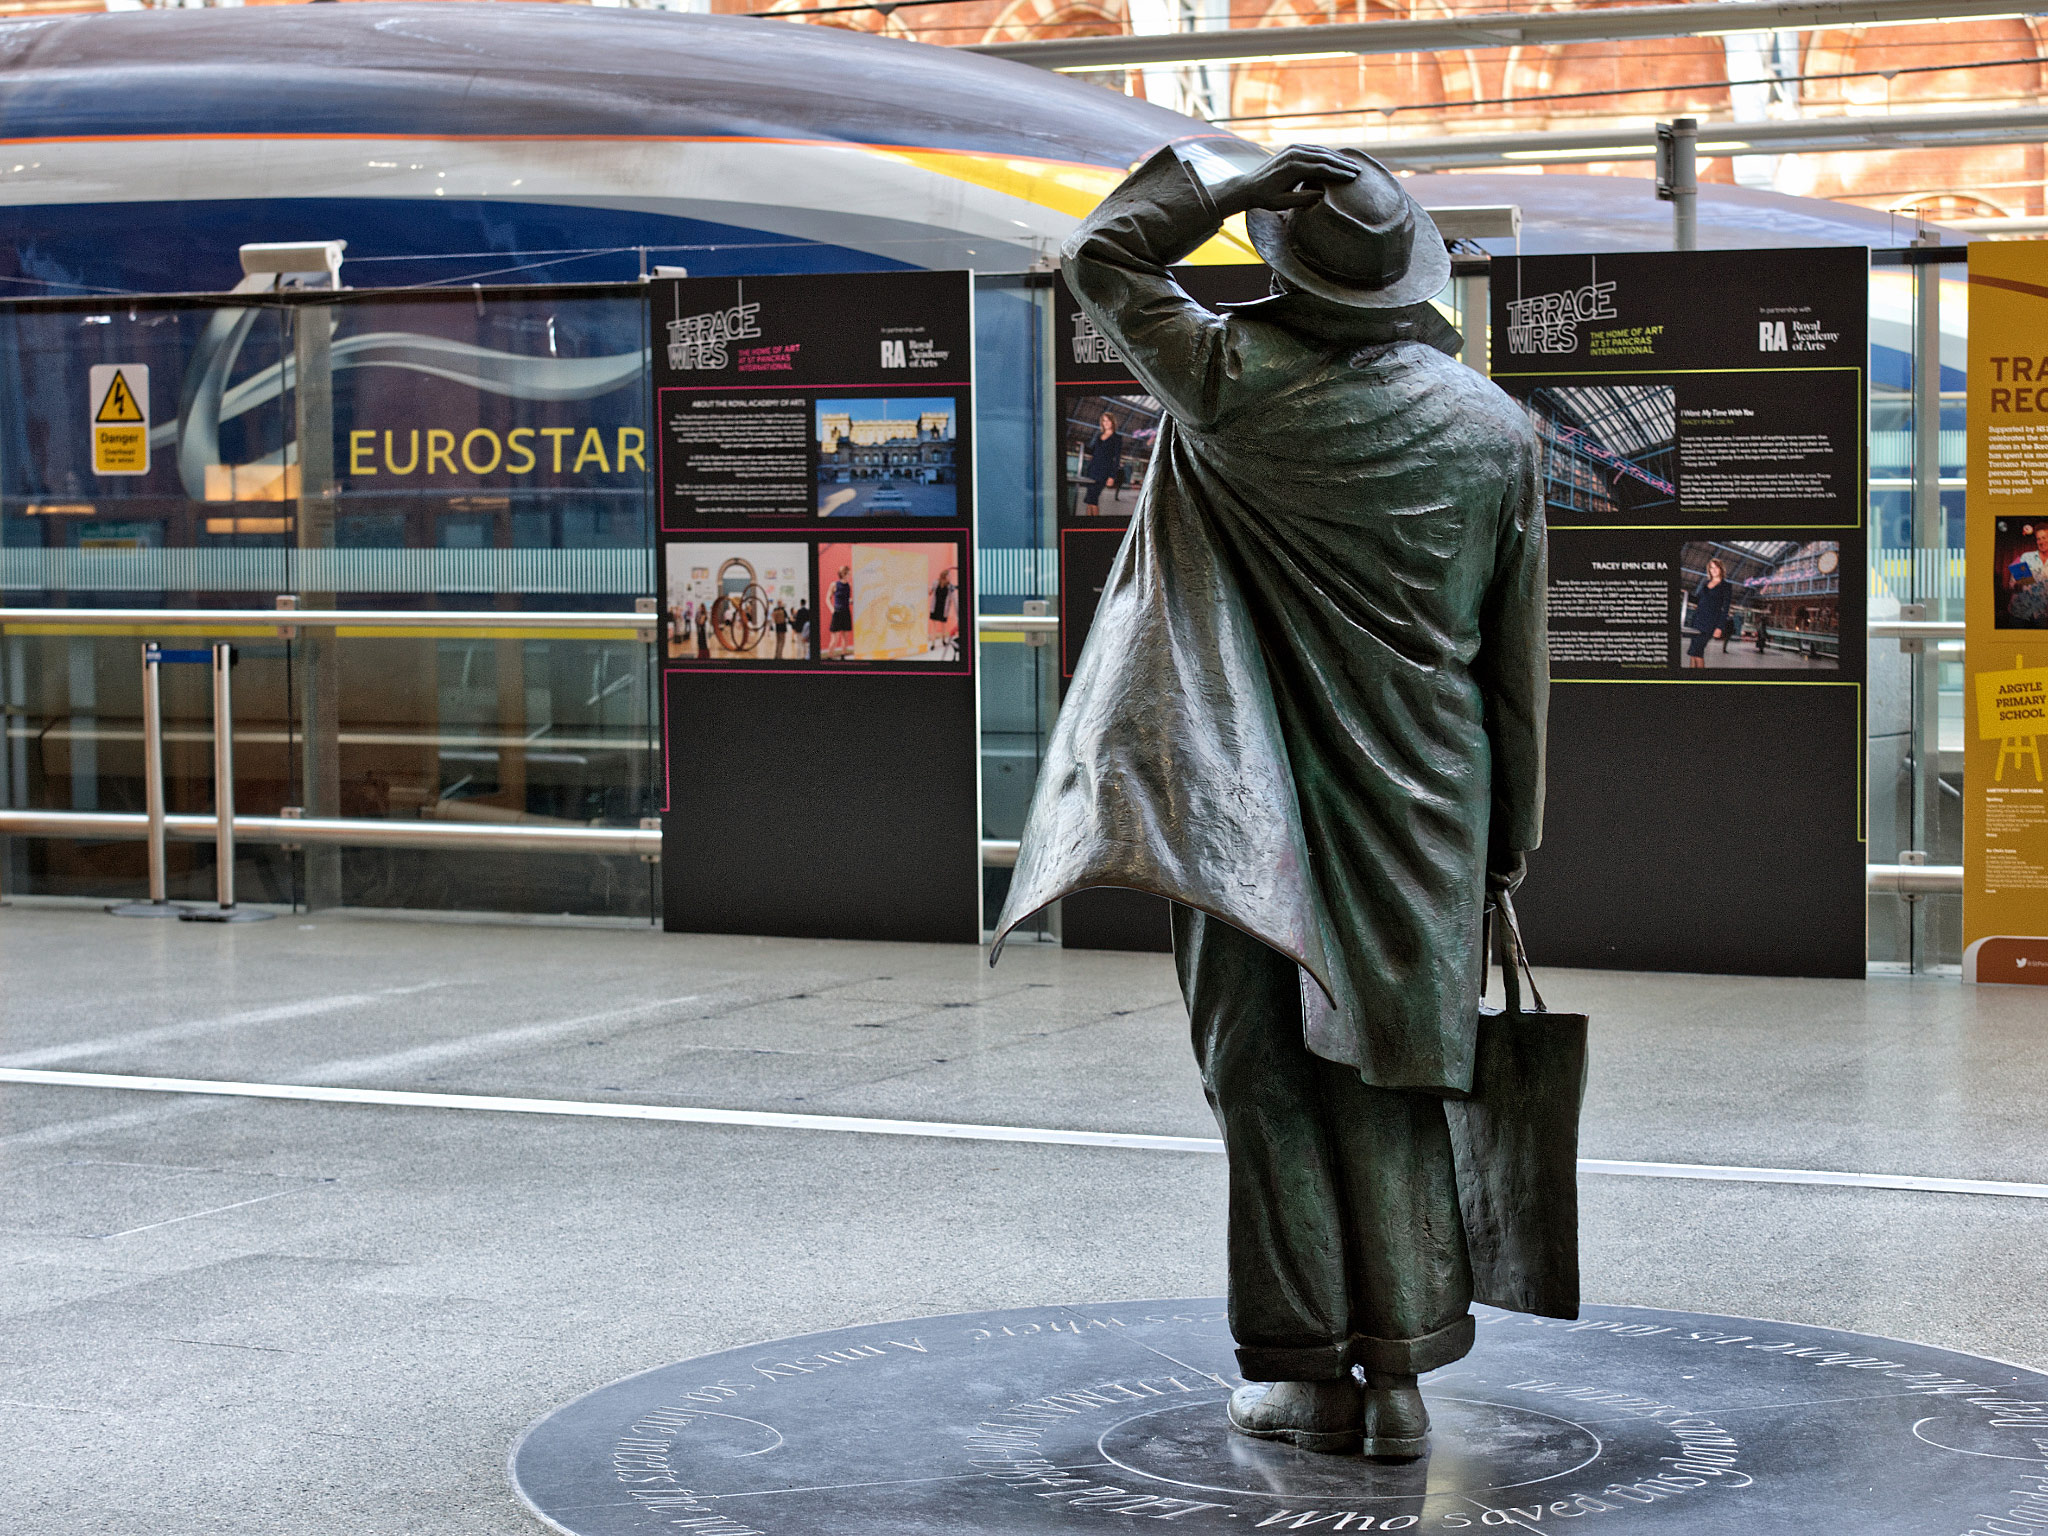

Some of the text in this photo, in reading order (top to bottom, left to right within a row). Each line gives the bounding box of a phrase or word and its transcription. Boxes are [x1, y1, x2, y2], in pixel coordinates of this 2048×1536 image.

[1506, 281, 1617, 327] TERRACE
[666, 302, 761, 343] TERRACE
[1590, 325, 1664, 339] THE HOME OF ART
[1792, 320, 1821, 333] Royal
[909, 339, 934, 351] Royal
[1507, 320, 1578, 354] WIRES
[1590, 336, 1653, 347] AT ST PANCRAS
[1759, 321, 1788, 352] RA
[1792, 341, 1826, 351] of Arts
[1793, 331, 1840, 343] Academy
[667, 341, 729, 370] WIRES
[881, 340, 906, 368] RA
[909, 350, 950, 360] Academy
[1072, 337, 1122, 363] WIRE
[1590, 346, 1655, 356] INTERNATIONAL
[920, 360, 938, 368] Arts
[100, 432, 139, 446] Danger
[350, 427, 651, 475] EUROSTAR
[1591, 562, 1620, 570] TRACEY
[1621, 562, 1640, 570] EMIN
[1641, 562, 1656, 570] CBE
[1999, 681, 2043, 694] ARGYLE
[1995, 695, 2047, 708] PRIMARY
[1999, 708, 2046, 721] SCHOOL
[962, 1316, 1128, 1341] where
[1515, 1317, 1679, 1338] fades
[1674, 1330, 1753, 1345] us
[886, 1337, 928, 1353] A
[1744, 1341, 1906, 1369] above
[752, 1345, 887, 1382] misty
[1884, 1369, 1998, 1395] blue
[1505, 1379, 1693, 1417] station
[613, 1437, 679, 1484] meets
[1658, 1418, 1753, 1488] glorious
[1603, 1472, 1708, 1504] this
[1034, 1485, 1232, 1519] POET
[1442, 1492, 1625, 1530] saved
[1255, 1508, 1420, 1531] Who
